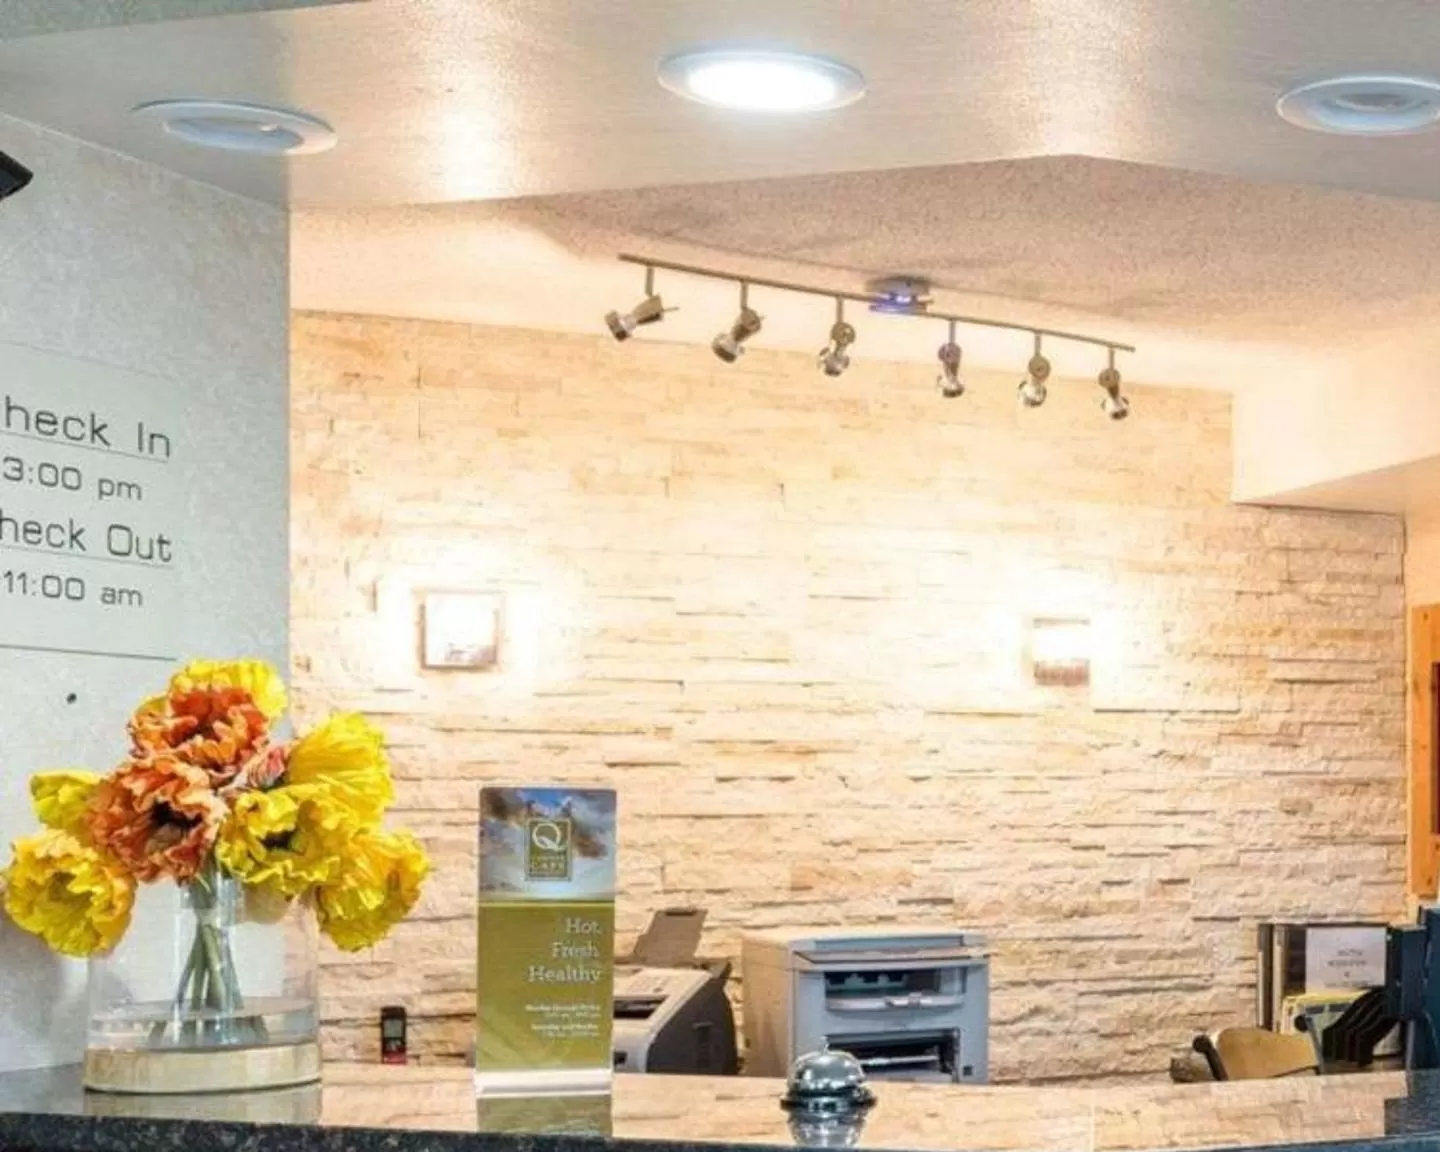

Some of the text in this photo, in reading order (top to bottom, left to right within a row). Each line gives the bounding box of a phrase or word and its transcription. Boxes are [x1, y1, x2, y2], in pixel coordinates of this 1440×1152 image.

[137, 421, 171, 457] In
[3, 456, 143, 500] 3:00 pm
[107, 524, 172, 562] Out
[3, 570, 143, 606] 11:00 am
[528, 964, 602, 985] Healthy
